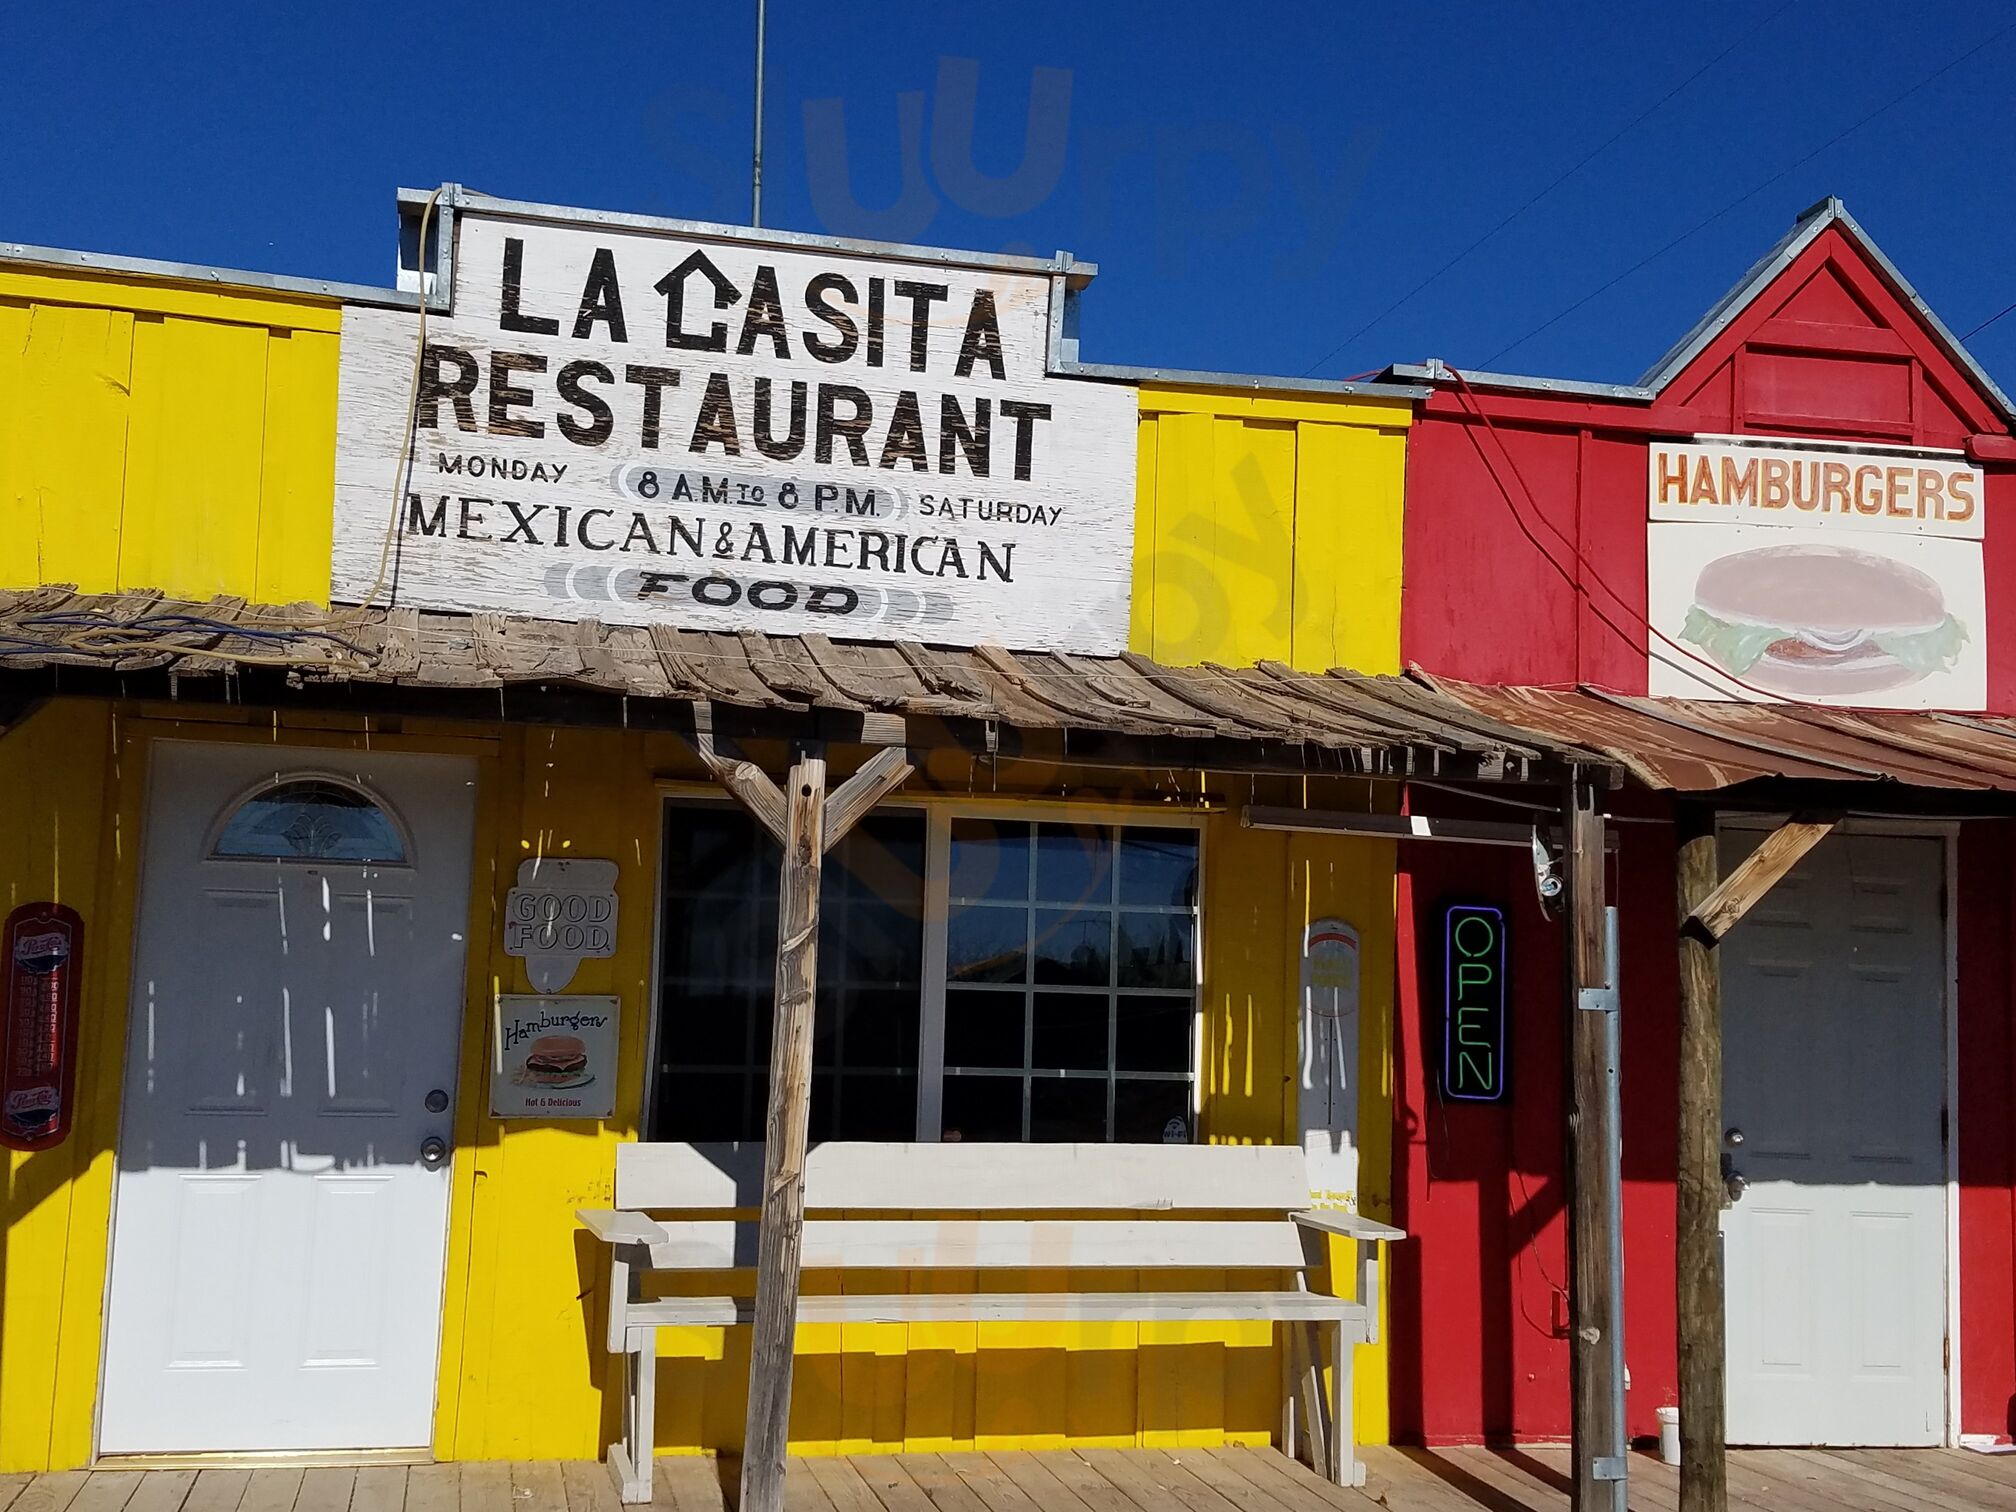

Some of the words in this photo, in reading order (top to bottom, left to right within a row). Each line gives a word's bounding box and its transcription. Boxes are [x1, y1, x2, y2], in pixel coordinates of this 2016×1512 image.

[499, 237, 629, 344] LA
[653, 249, 1007, 382] CASITA
[418, 343, 1053, 482] RESTAURANT
[438, 452, 568, 484] MONDAY
[637, 470, 661, 500] 8
[736, 482, 767, 506] TO
[777, 481, 799, 510] 8
[814, 484, 881, 518] P.M.
[918, 494, 1063, 527] SATURDAY
[1656, 452, 1976, 523] HAMBURGERS
[407, 493, 706, 558] MEXICAN
[712, 521, 735, 559] &
[740, 522, 1016, 583] AMERICAN
[637, 571, 860, 616] FOOD
[512, 893, 612, 923] GOOD
[513, 923, 609, 951] FOOD
[504, 1010, 608, 1051] Hamburgers
[1454, 916, 1494, 1091] OPEN
[525, 1098, 538, 1107] Hot
[547, 1098, 581, 1107] Delicious
